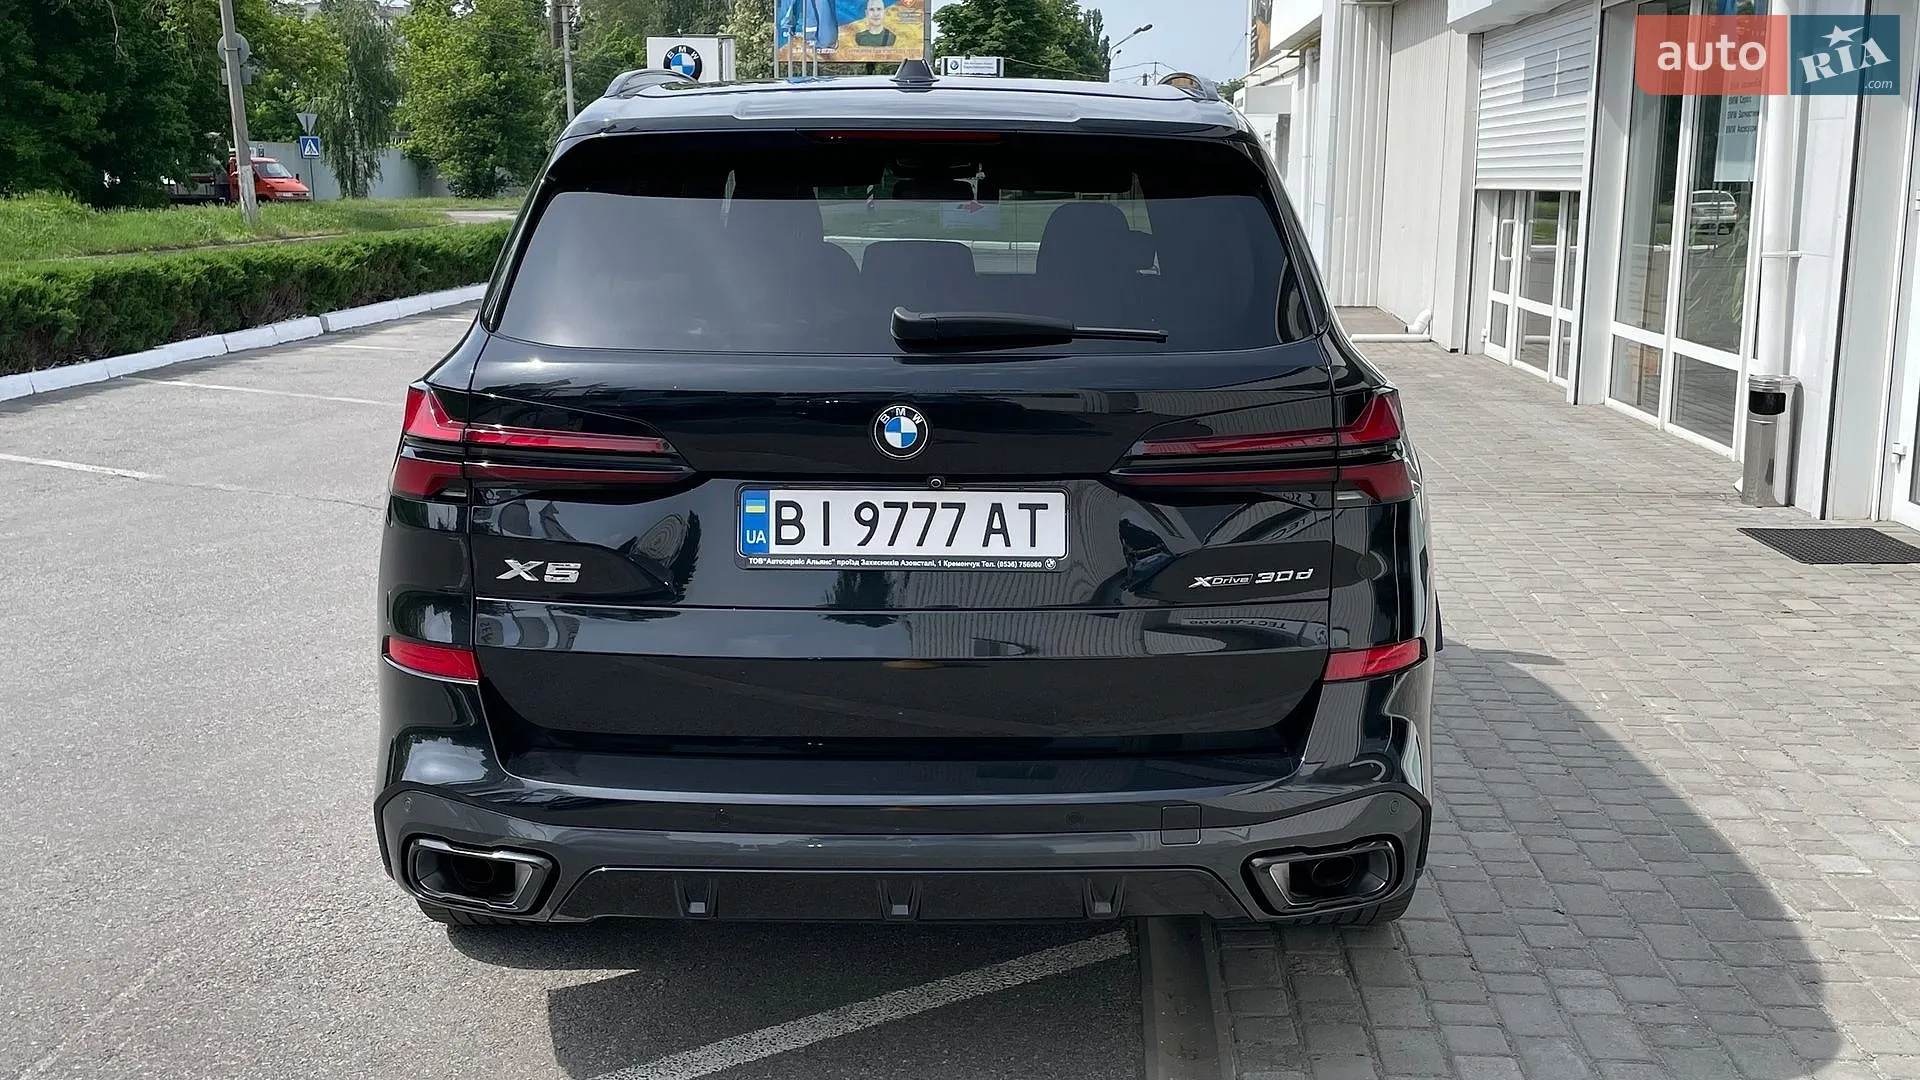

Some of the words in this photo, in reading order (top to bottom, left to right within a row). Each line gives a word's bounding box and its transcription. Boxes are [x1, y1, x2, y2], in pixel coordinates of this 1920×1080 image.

[667, 46, 699, 60] BMW
[879, 407, 923, 425] BMW
[774, 500, 830, 547] BI
[853, 501, 967, 547] 9777
[981, 502, 1049, 548] AT
[745, 528, 767, 545] UA
[495, 559, 582, 583] X5
